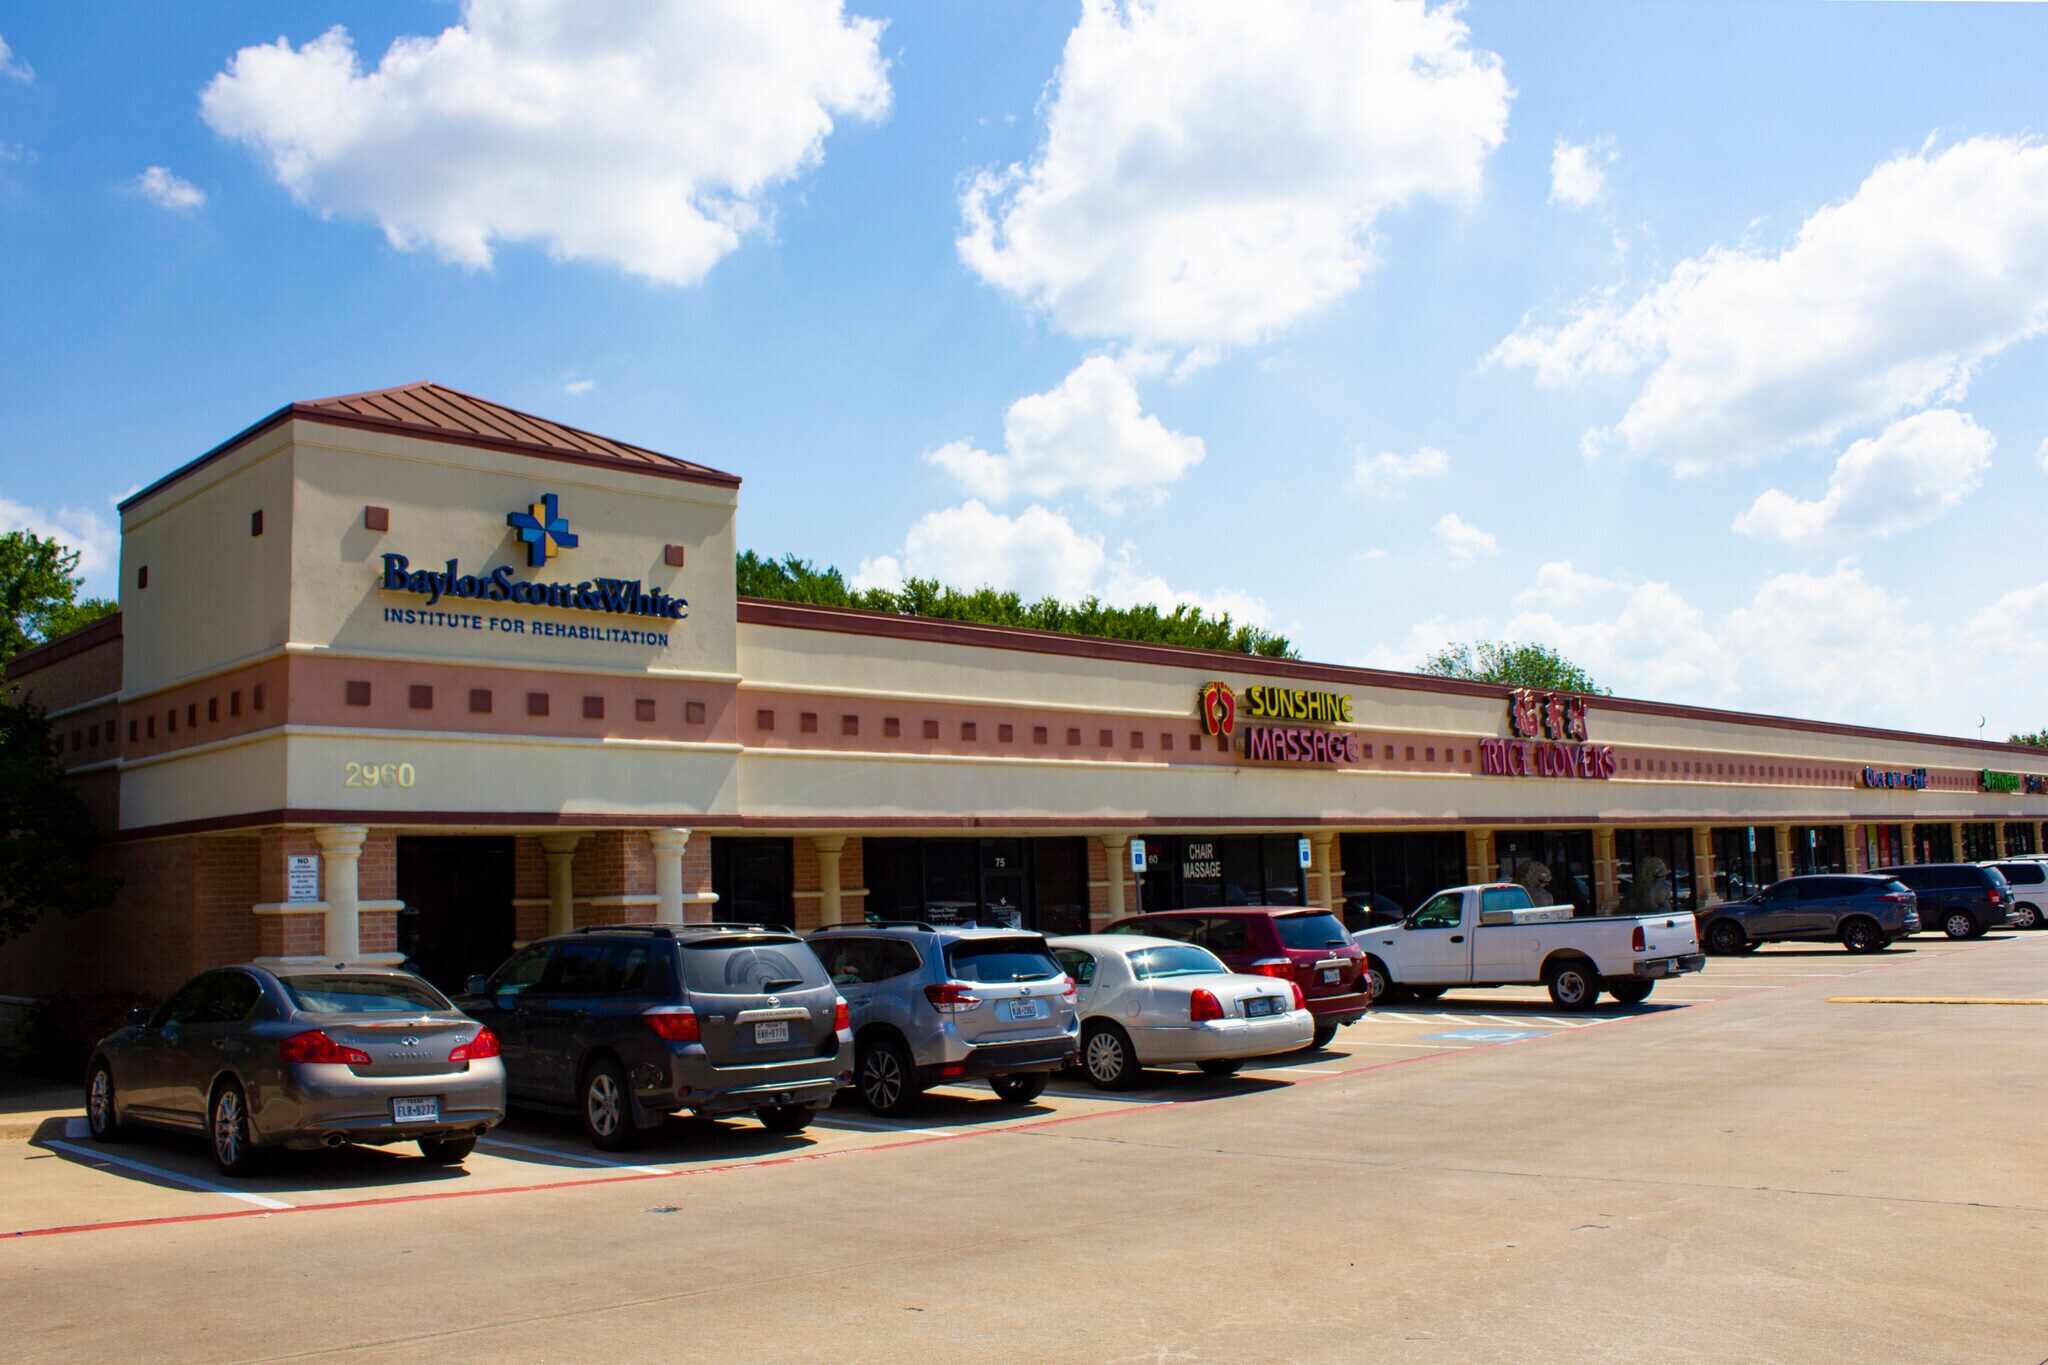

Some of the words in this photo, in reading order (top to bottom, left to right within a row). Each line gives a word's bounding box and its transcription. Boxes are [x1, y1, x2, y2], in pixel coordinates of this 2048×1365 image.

[384, 608, 482, 630] INSTITUTE
[490, 617, 525, 634] FOR
[532, 622, 669, 647] REHABILITATION
[1247, 685, 1353, 722] SUNSHINE
[1246, 726, 1358, 763] MASSAGE
[1480, 738, 1534, 777] RICE
[1537, 741, 1616, 779] LOVERS
[344, 761, 415, 790] 2960
[1991, 773, 2020, 791] FITNESS
[995, 857, 1005, 868] 75
[1148, 855, 1158, 864] 60
[1189, 843, 1213, 860] CHAIR
[1183, 861, 1221, 879] MASSAGE
